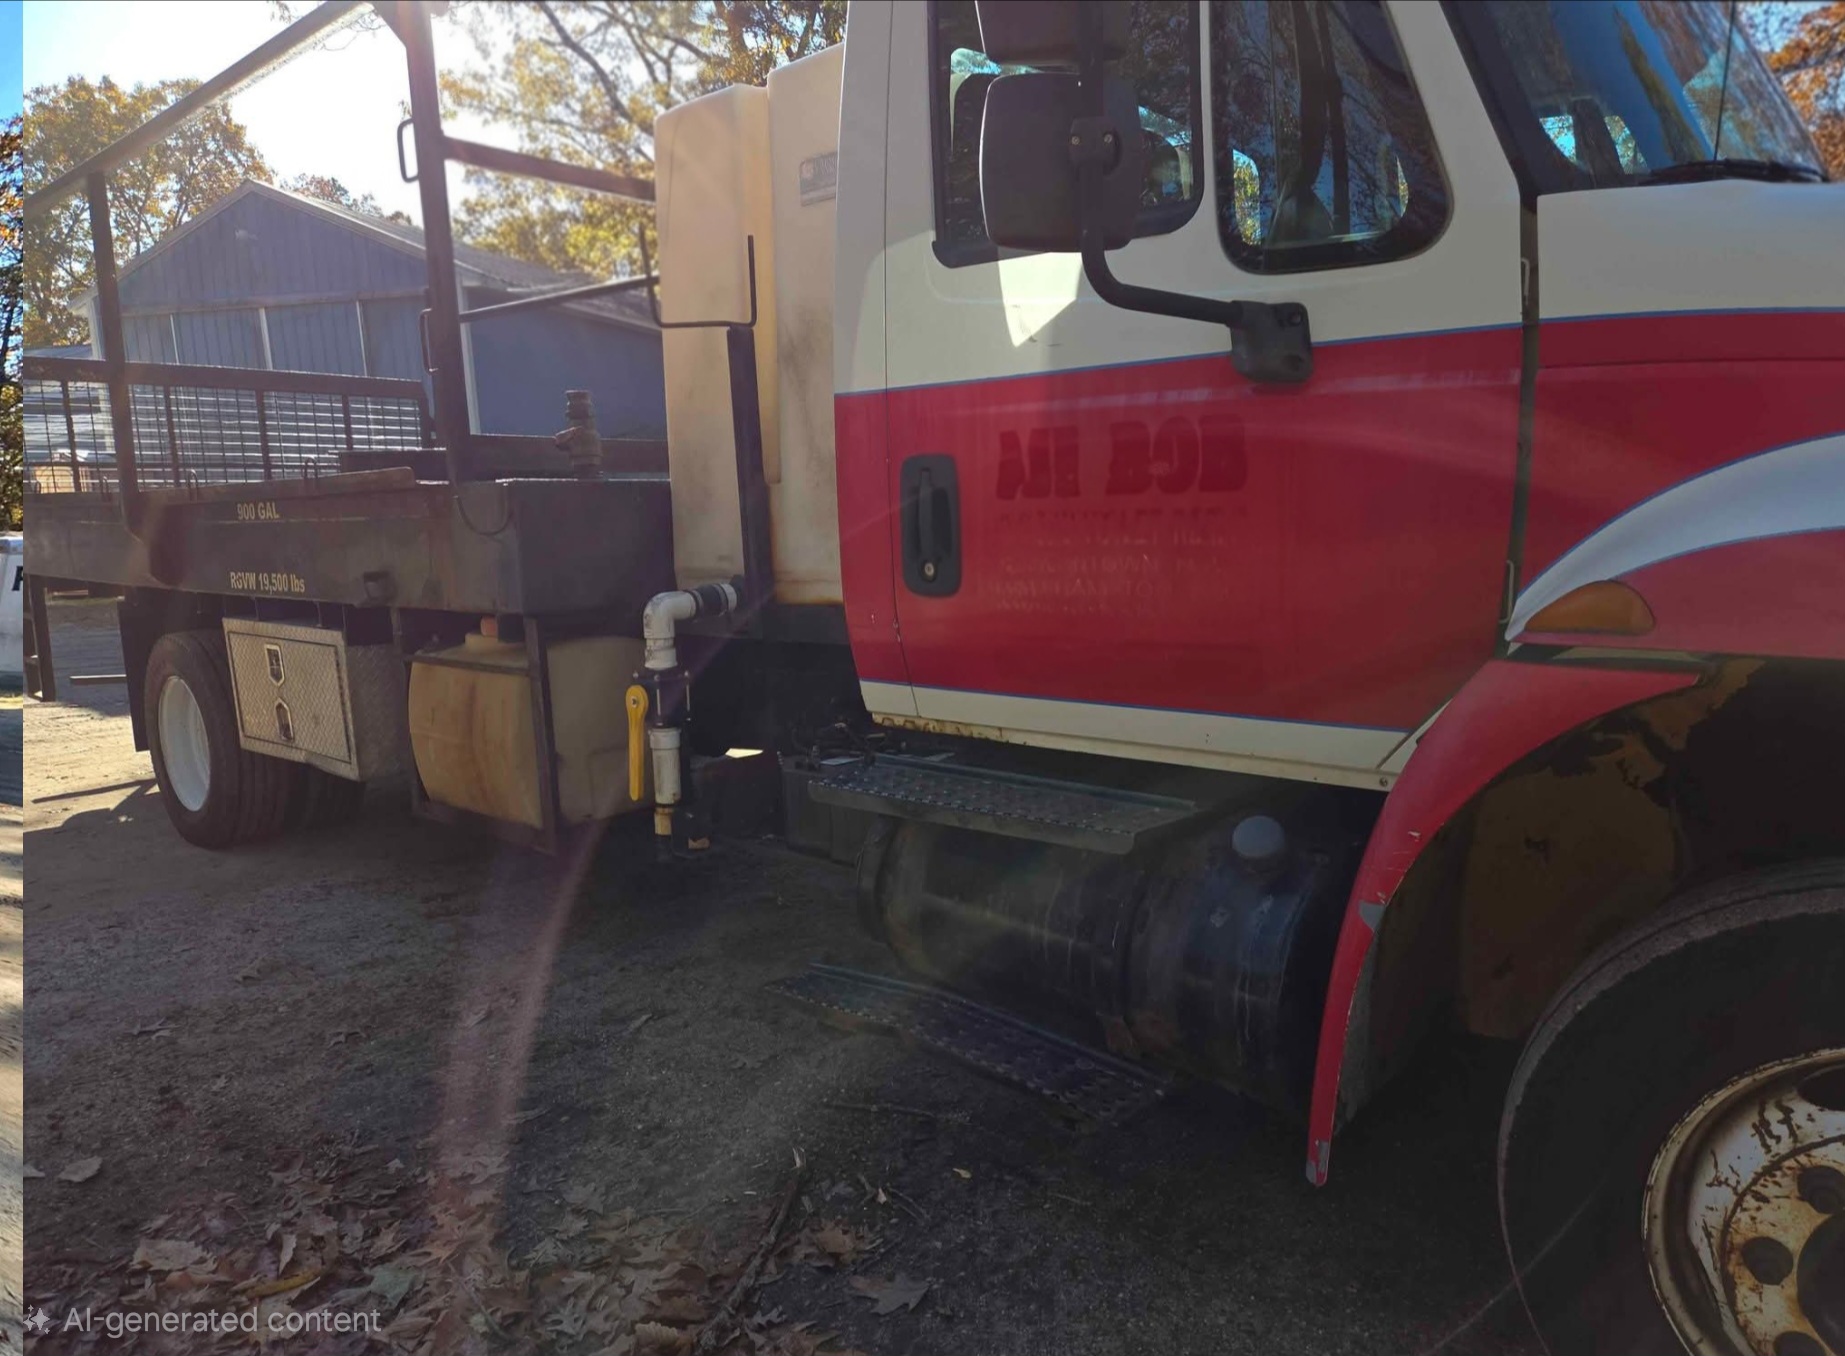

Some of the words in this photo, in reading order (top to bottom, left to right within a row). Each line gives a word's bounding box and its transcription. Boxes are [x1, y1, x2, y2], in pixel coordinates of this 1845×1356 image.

[237, 503, 255, 520] 900
[258, 502, 279, 519] GAL
[258, 573, 288, 595] 19,500
[290, 574, 306, 592] lbs
